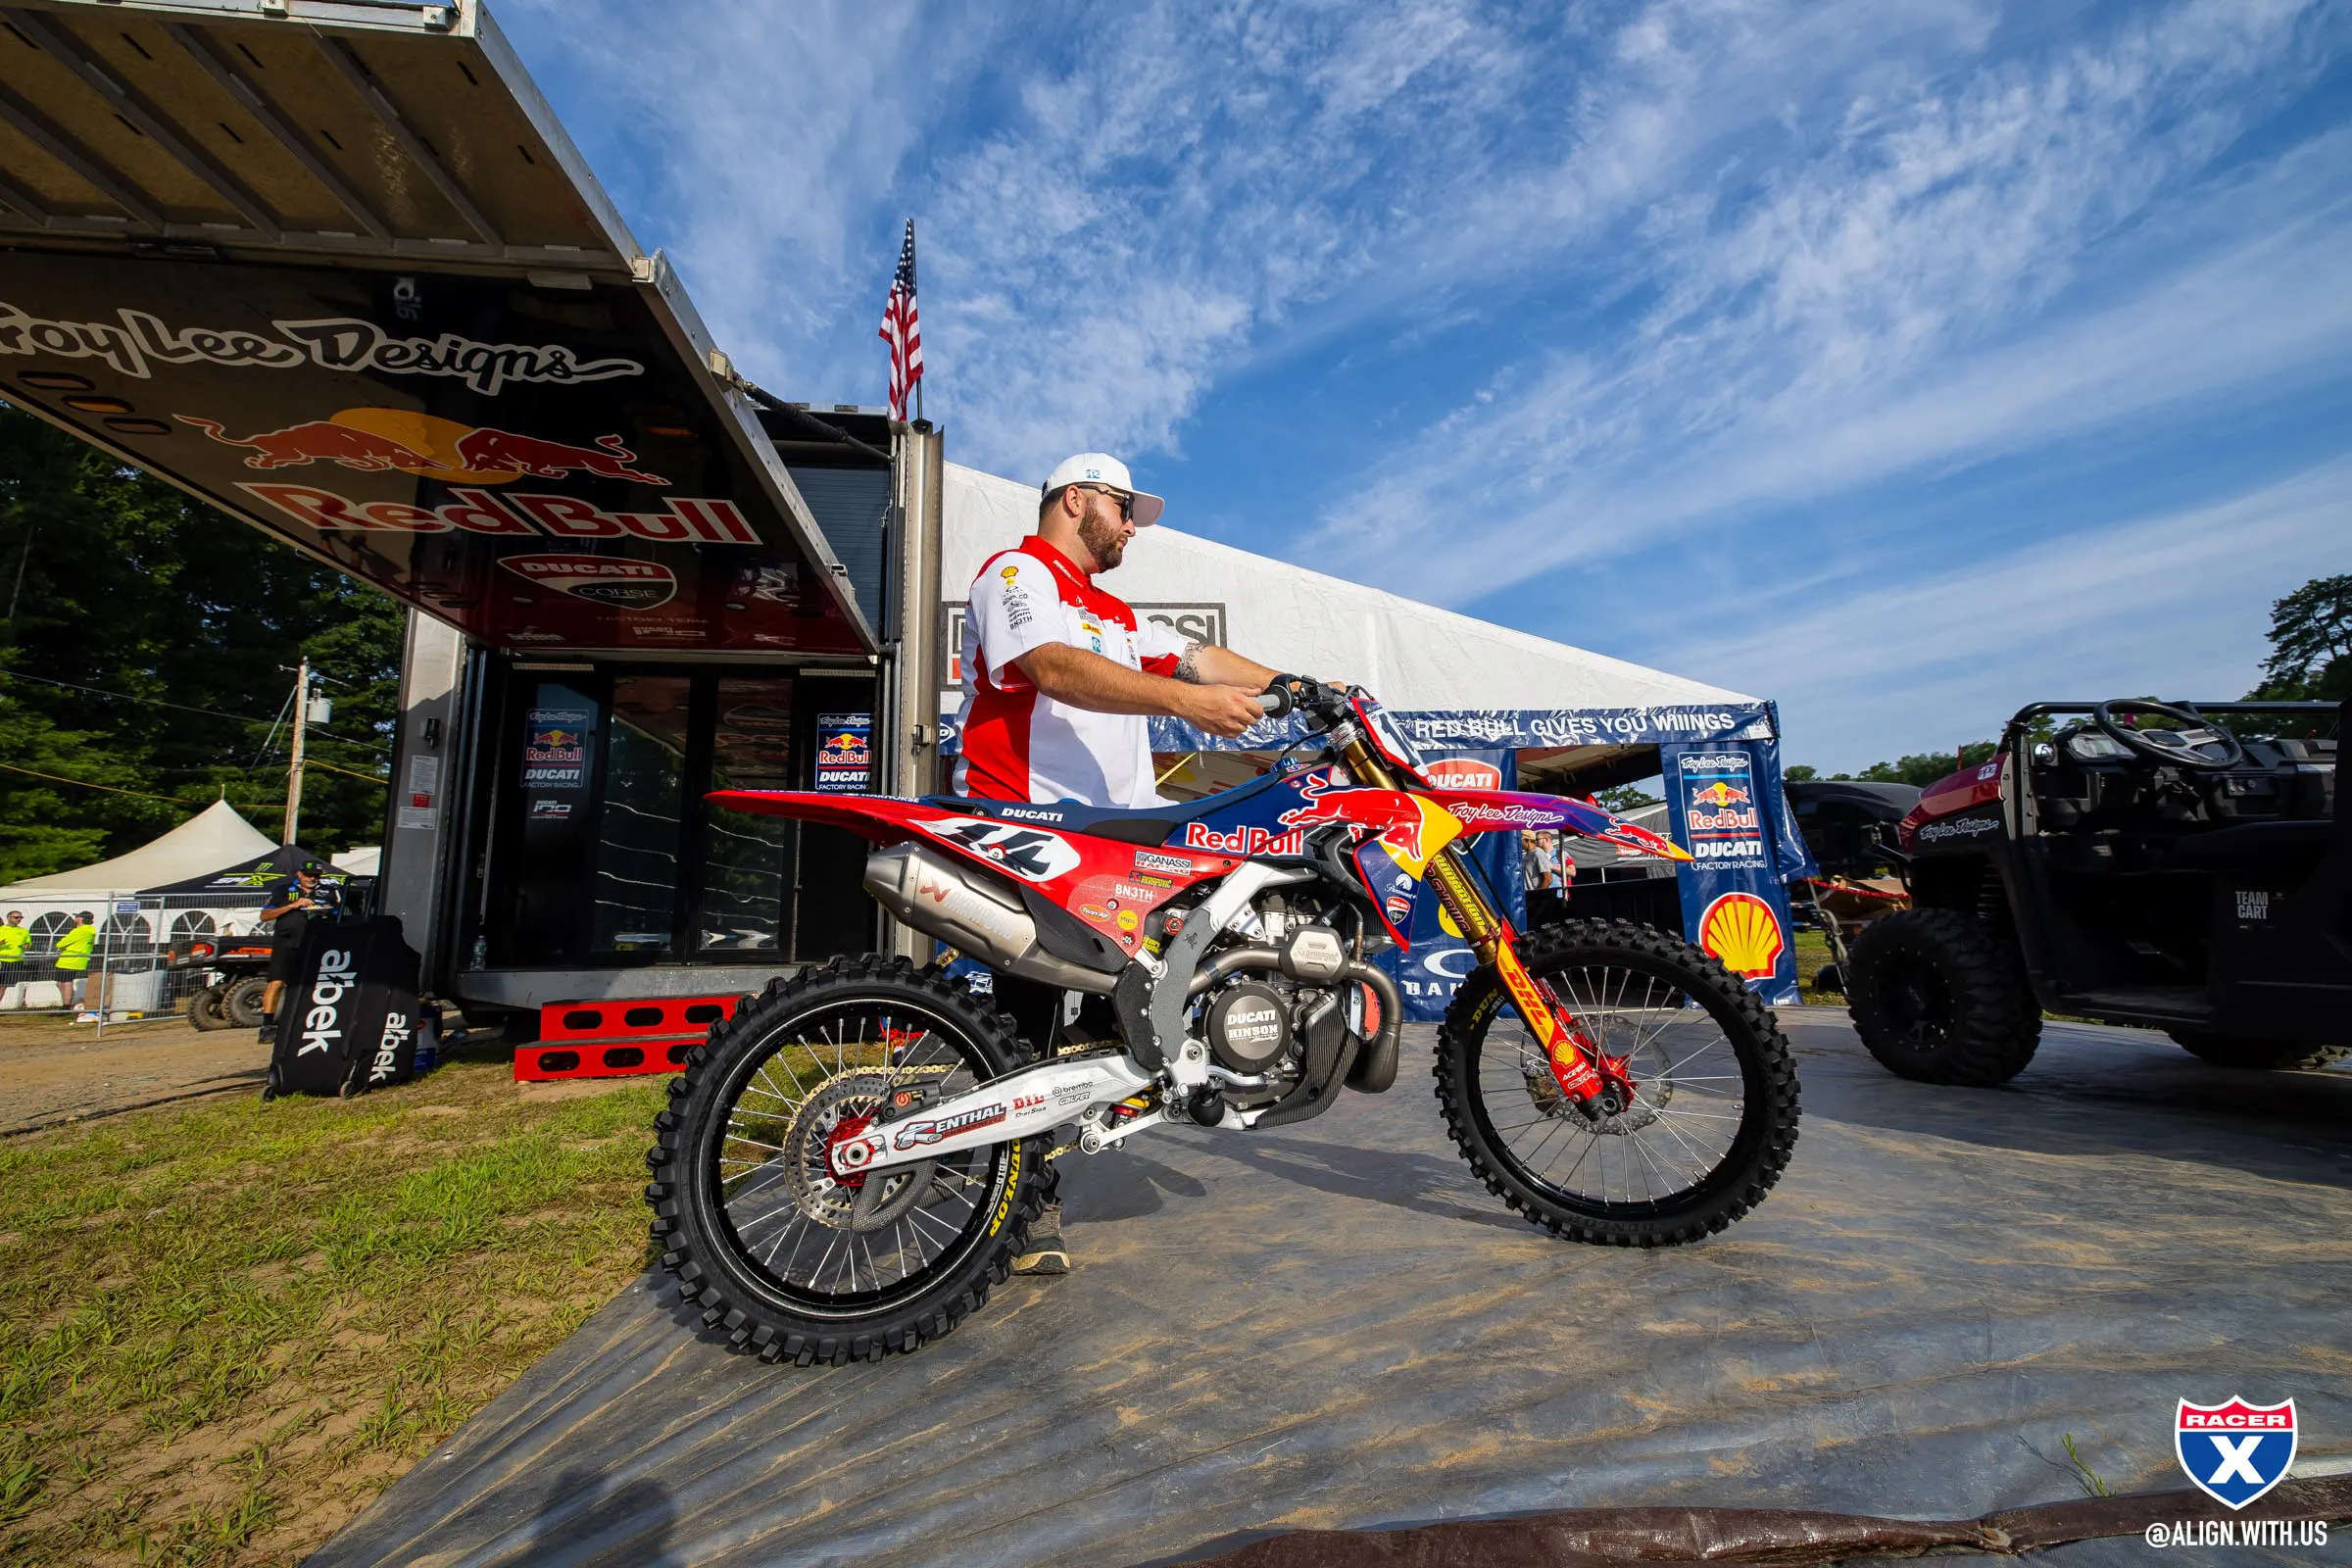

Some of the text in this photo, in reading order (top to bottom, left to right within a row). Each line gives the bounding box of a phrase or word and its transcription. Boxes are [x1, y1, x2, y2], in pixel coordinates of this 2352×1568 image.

[0, 302, 644, 395] roy Lee Designs
[233, 482, 764, 544] Red Bull
[521, 562, 654, 576] DUCATI
[578, 587, 660, 599] CORSE
[1415, 719, 1461, 738] RED
[1468, 718, 1527, 737] BULL
[1531, 716, 1598, 735] GIVES
[1600, 716, 1648, 733] YOU
[526, 747, 583, 761] Red Bull
[819, 750, 871, 764] Red Bull
[1682, 756, 1749, 773] Troy Lee Designs
[525, 768, 581, 780] DUCATI
[818, 771, 870, 782] DUCATI
[1428, 772, 1494, 788] DUCATI
[1001, 808, 1063, 822] DUCATI
[1448, 802, 1565, 828] Troy Lee Designs
[1688, 808, 1759, 830] Red Bull
[1186, 822, 1303, 856] Red Bull
[1695, 841, 1762, 858] DUCATI
[1147, 855, 1192, 869] GANASSI
[1696, 860, 1765, 870] FACTORY RACING
[1114, 883, 1153, 902] BN3TH
[2234, 891, 2269, 906] TEAM
[2237, 905, 2268, 919] CART
[298, 950, 357, 1058] albek
[1505, 969, 1547, 1027] DHL
[1227, 1009, 1276, 1025] DUCATI
[1228, 1024, 1278, 1039] HINSON
[1063, 1081, 1093, 1093] brembo
